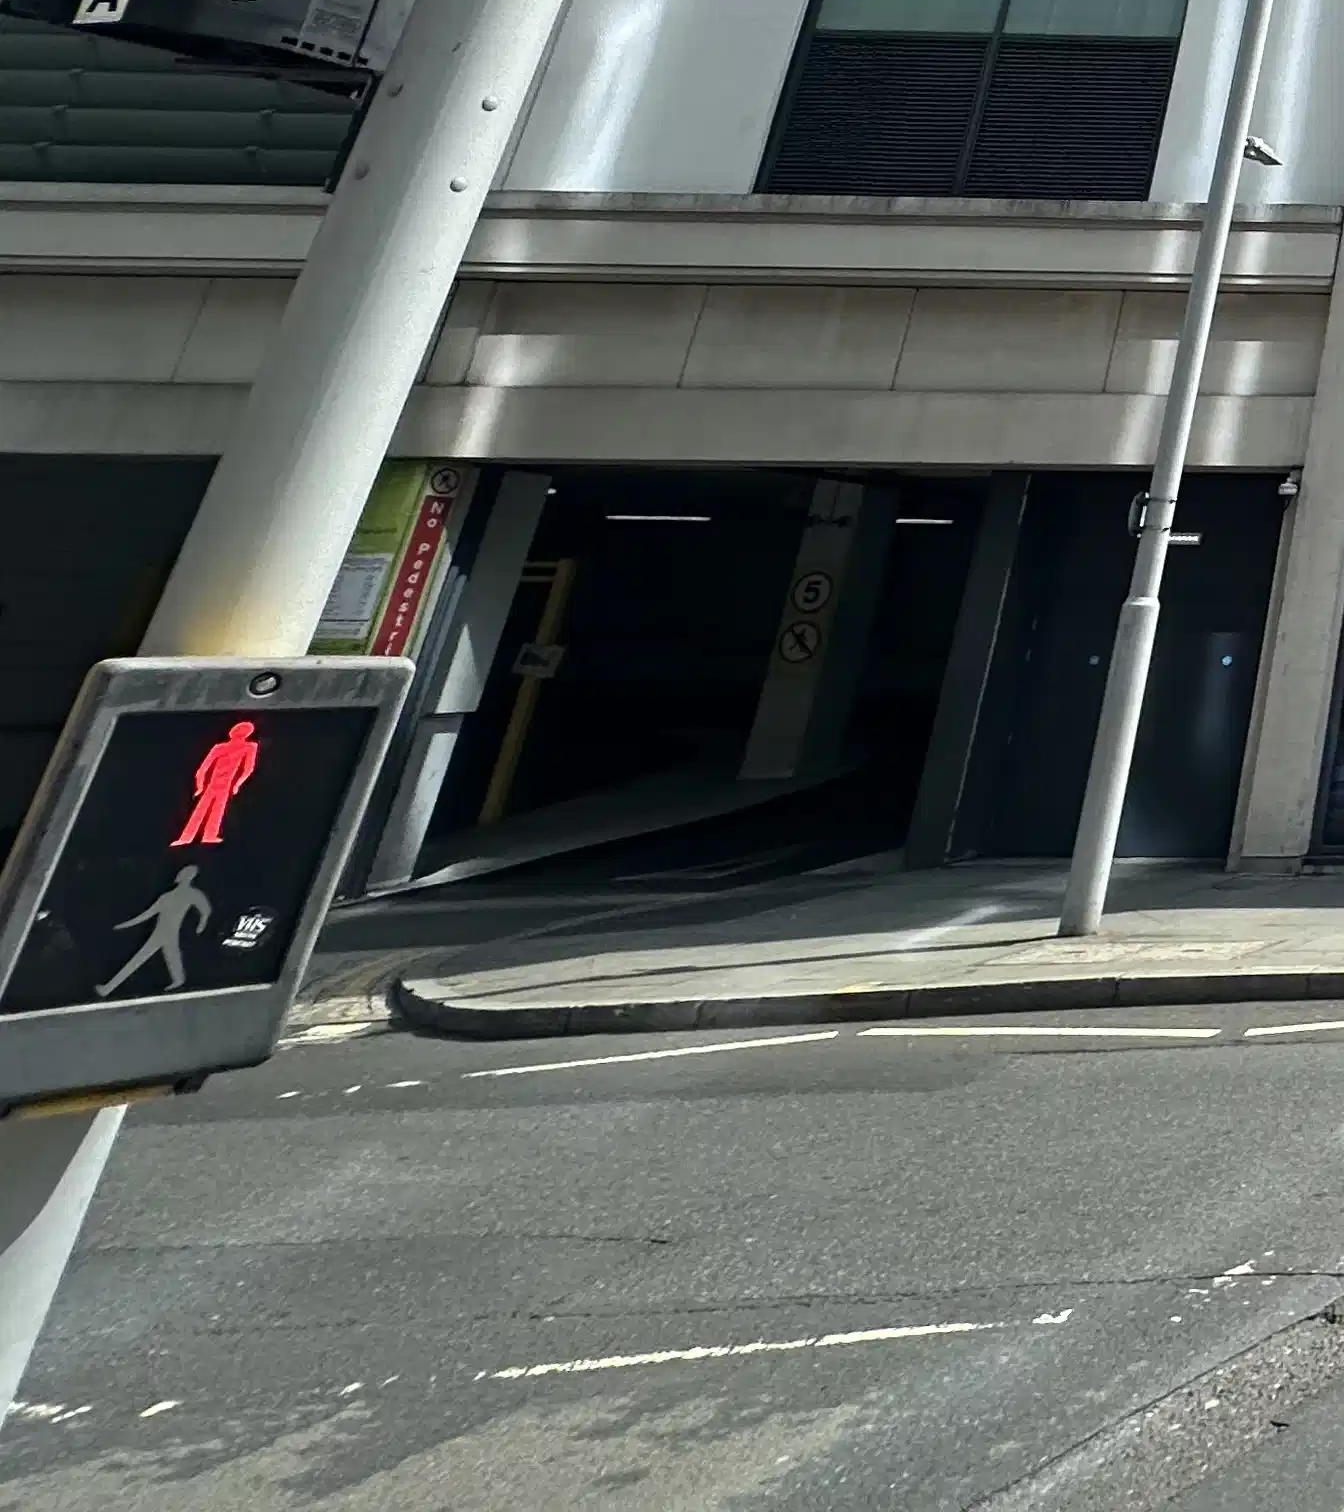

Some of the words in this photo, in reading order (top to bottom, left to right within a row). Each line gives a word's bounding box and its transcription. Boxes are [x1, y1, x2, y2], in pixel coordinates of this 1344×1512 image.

[426, 501, 444, 529] No
[384, 543, 431, 656] Pedestri
[803, 580, 821, 603] 5
